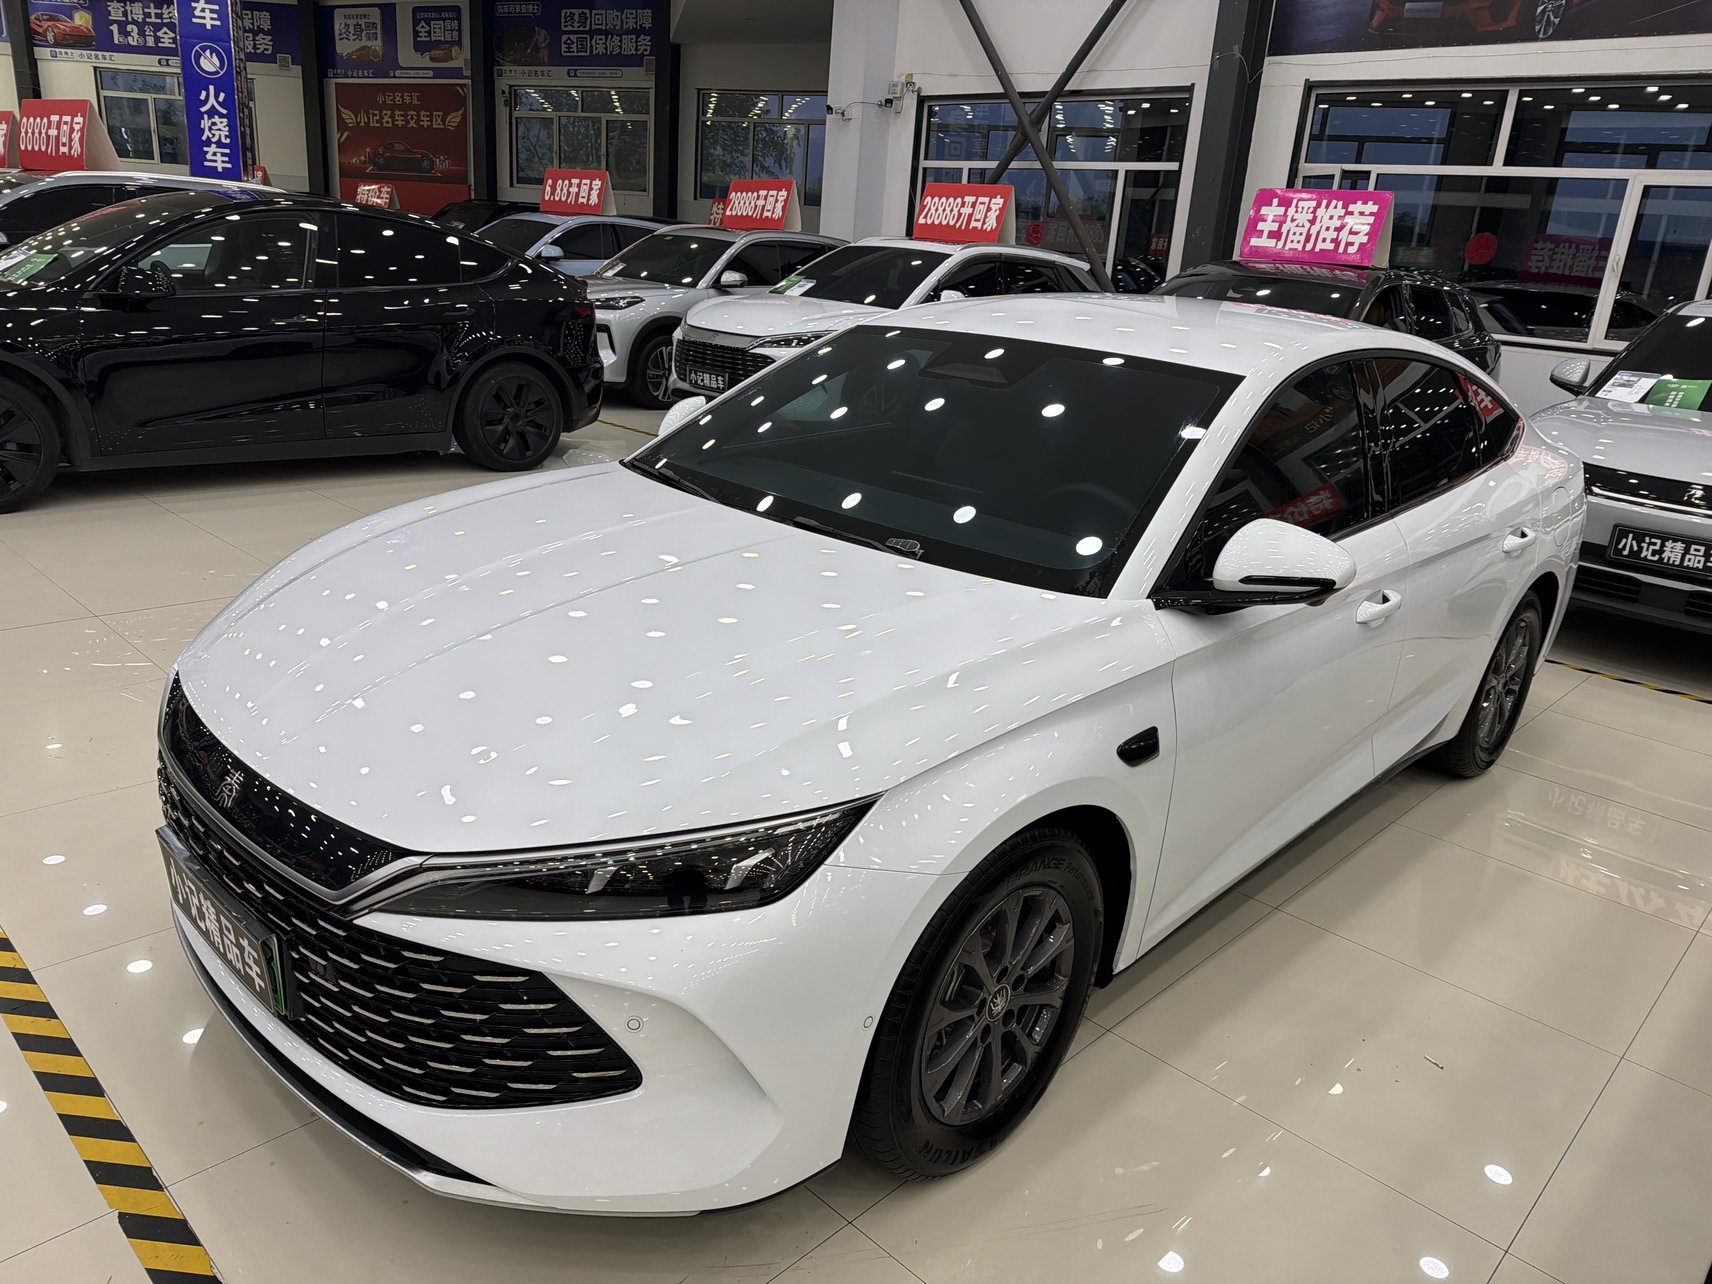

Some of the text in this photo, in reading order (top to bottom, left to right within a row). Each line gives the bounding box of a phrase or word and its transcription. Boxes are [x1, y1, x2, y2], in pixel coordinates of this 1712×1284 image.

[376, 92, 421, 105] 小记名车汇
[20, 112, 84, 158] 8888开回家
[199, 84, 233, 173] 火烧车
[357, 109, 445, 129] 小记名车交车区
[544, 178, 602, 206] 6.88开回家
[725, 187, 788, 221] 28888开回家
[918, 194, 1005, 232] 28888开回家
[1250, 199, 1379, 254] 主播推荐
[690, 370, 725, 390] 小记精品车
[169, 857, 266, 992] 小记精品车
